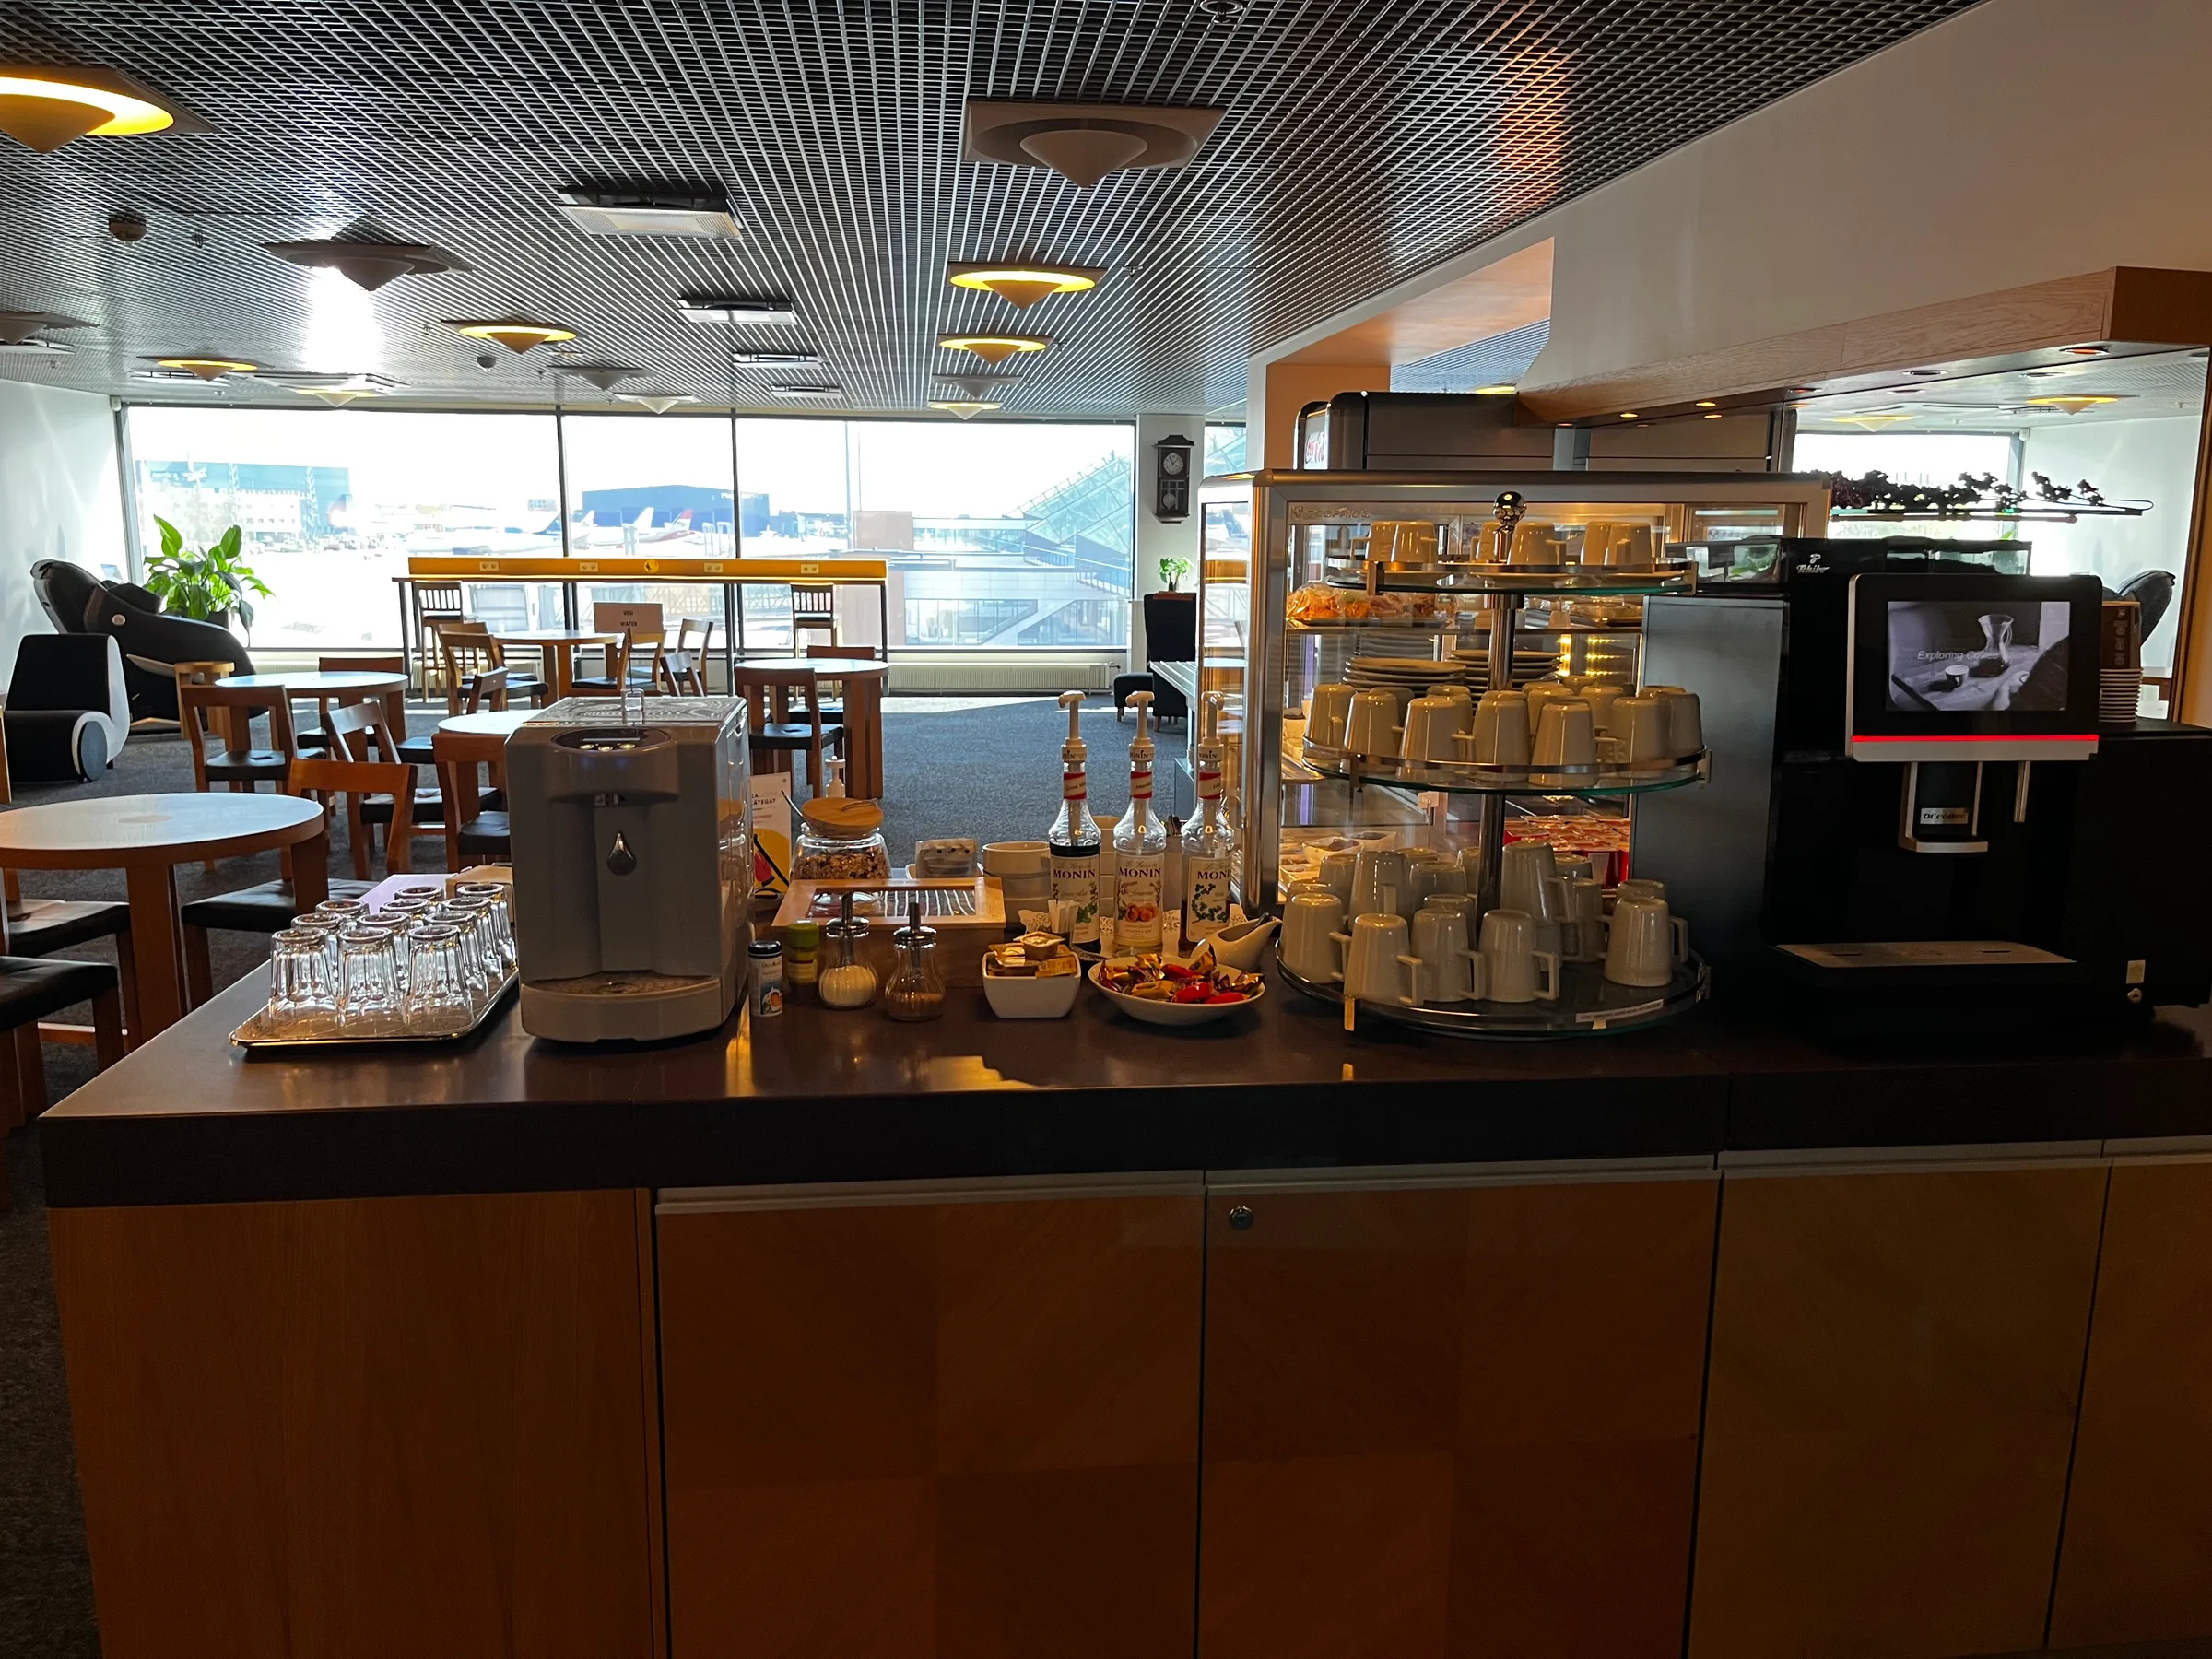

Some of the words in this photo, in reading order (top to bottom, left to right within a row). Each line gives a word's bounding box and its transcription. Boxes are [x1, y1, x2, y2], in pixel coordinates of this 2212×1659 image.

[1917, 650, 1963, 661] Exploring
[1053, 869, 1096, 879] MONIN
[1119, 867, 1161, 877] MONIN
